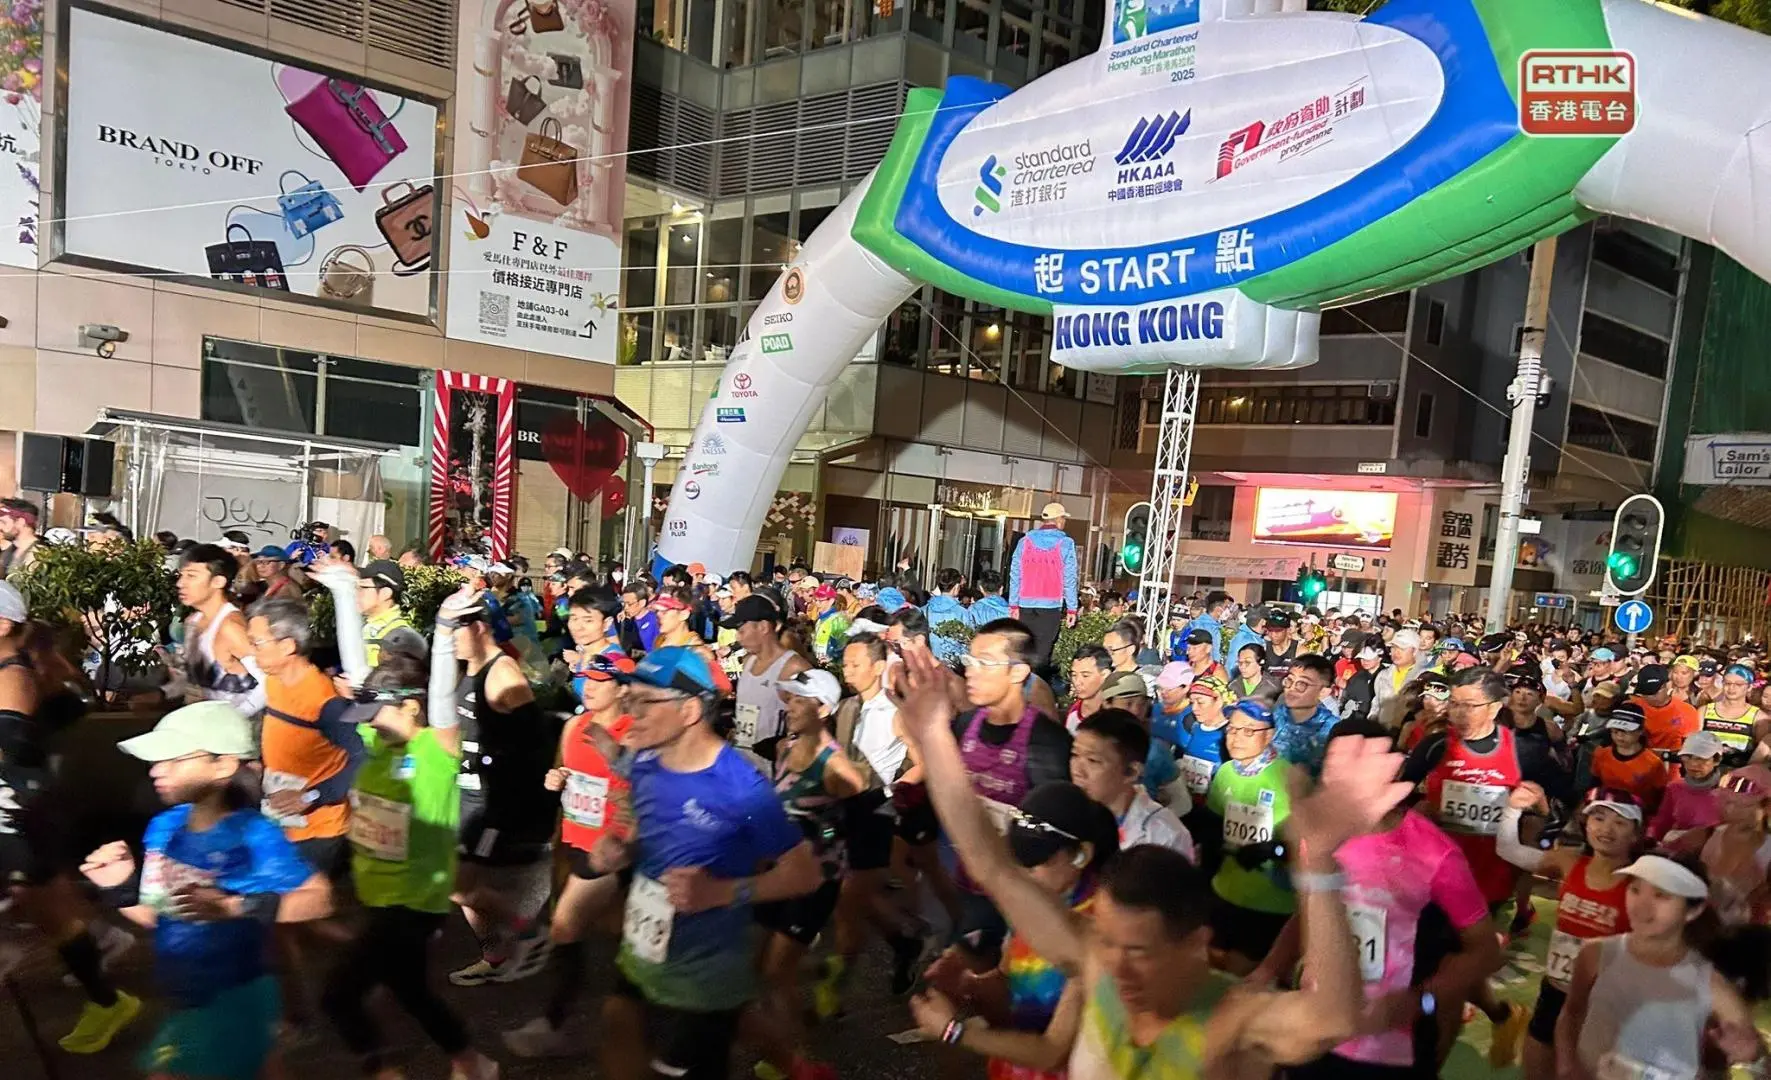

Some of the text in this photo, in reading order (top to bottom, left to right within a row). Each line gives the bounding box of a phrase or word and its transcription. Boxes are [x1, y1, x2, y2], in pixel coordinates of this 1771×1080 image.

[1107, 45, 1196, 72] Hong Kong Marathon
[1109, 31, 1199, 60] Standard Chartered
[1171, 68, 1195, 82] 2025
[1266, 86, 1365, 138] 政府資助計劃
[98, 124, 264, 175] BRAND OFF
[1014, 139, 1092, 170] standard
[1234, 117, 1329, 169] Government-funded
[1280, 127, 1333, 160] programme
[154, 156, 211, 176] TOKYO
[1013, 157, 1096, 186] chartered
[1117, 161, 1175, 184] HKAAA
[1010, 181, 1067, 208] 渣打銀行
[1107, 178, 1183, 201] 中國香港田徑總會
[513, 231, 568, 260] F & F
[1034, 228, 1255, 294] 起 START 點
[492, 268, 583, 300] 價格接近專門店
[764, 312, 793, 325] SEIKO
[1056, 301, 1224, 350] HONG KONG
[764, 335, 789, 351] POAD
[732, 390, 758, 398] TOYOTA
[1727, 448, 1770, 461] Sam's
[1445, 801, 1503, 822] 55082
[1226, 820, 1269, 843] 57020
